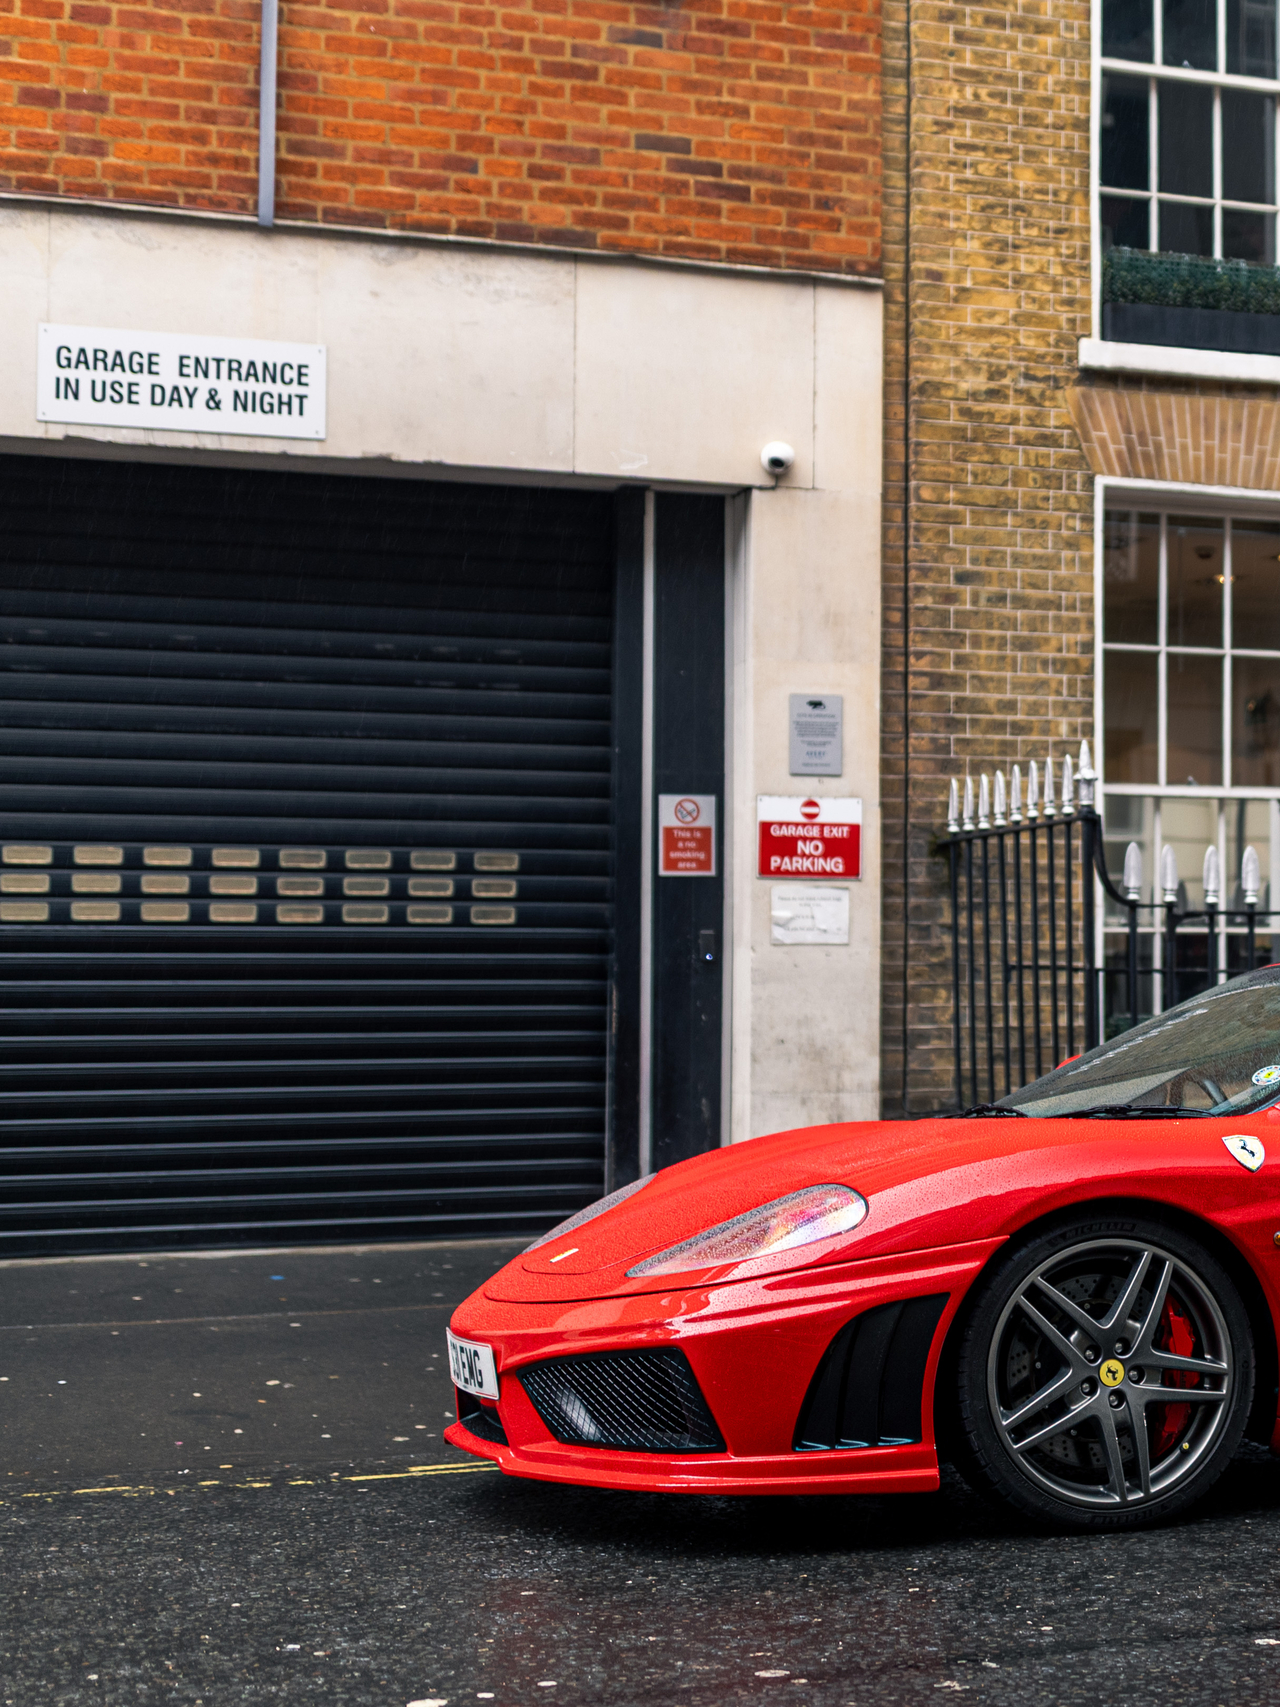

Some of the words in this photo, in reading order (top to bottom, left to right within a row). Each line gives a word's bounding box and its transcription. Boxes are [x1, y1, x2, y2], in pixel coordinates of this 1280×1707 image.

[55, 345, 160, 376] GARAGE
[178, 354, 310, 387] ENTRANCE
[54, 376, 80, 401] IN
[91, 379, 140, 406] USE
[150, 384, 198, 409] DAY
[205, 387, 222, 411] &
[233, 390, 308, 417] NIGHT
[672, 829, 692, 838] This
[693, 829, 702, 839] is
[770, 824, 821, 838] GARAGE
[823, 825, 850, 839] EXIT
[677, 841, 684, 849] a
[685, 841, 697, 850] no
[797, 839, 825, 857] NO
[669, 850, 706, 862] smoking
[677, 861, 697, 870] area
[770, 855, 845, 874] PARKING
[1064, 1222, 1135, 1239] MICHELIN
